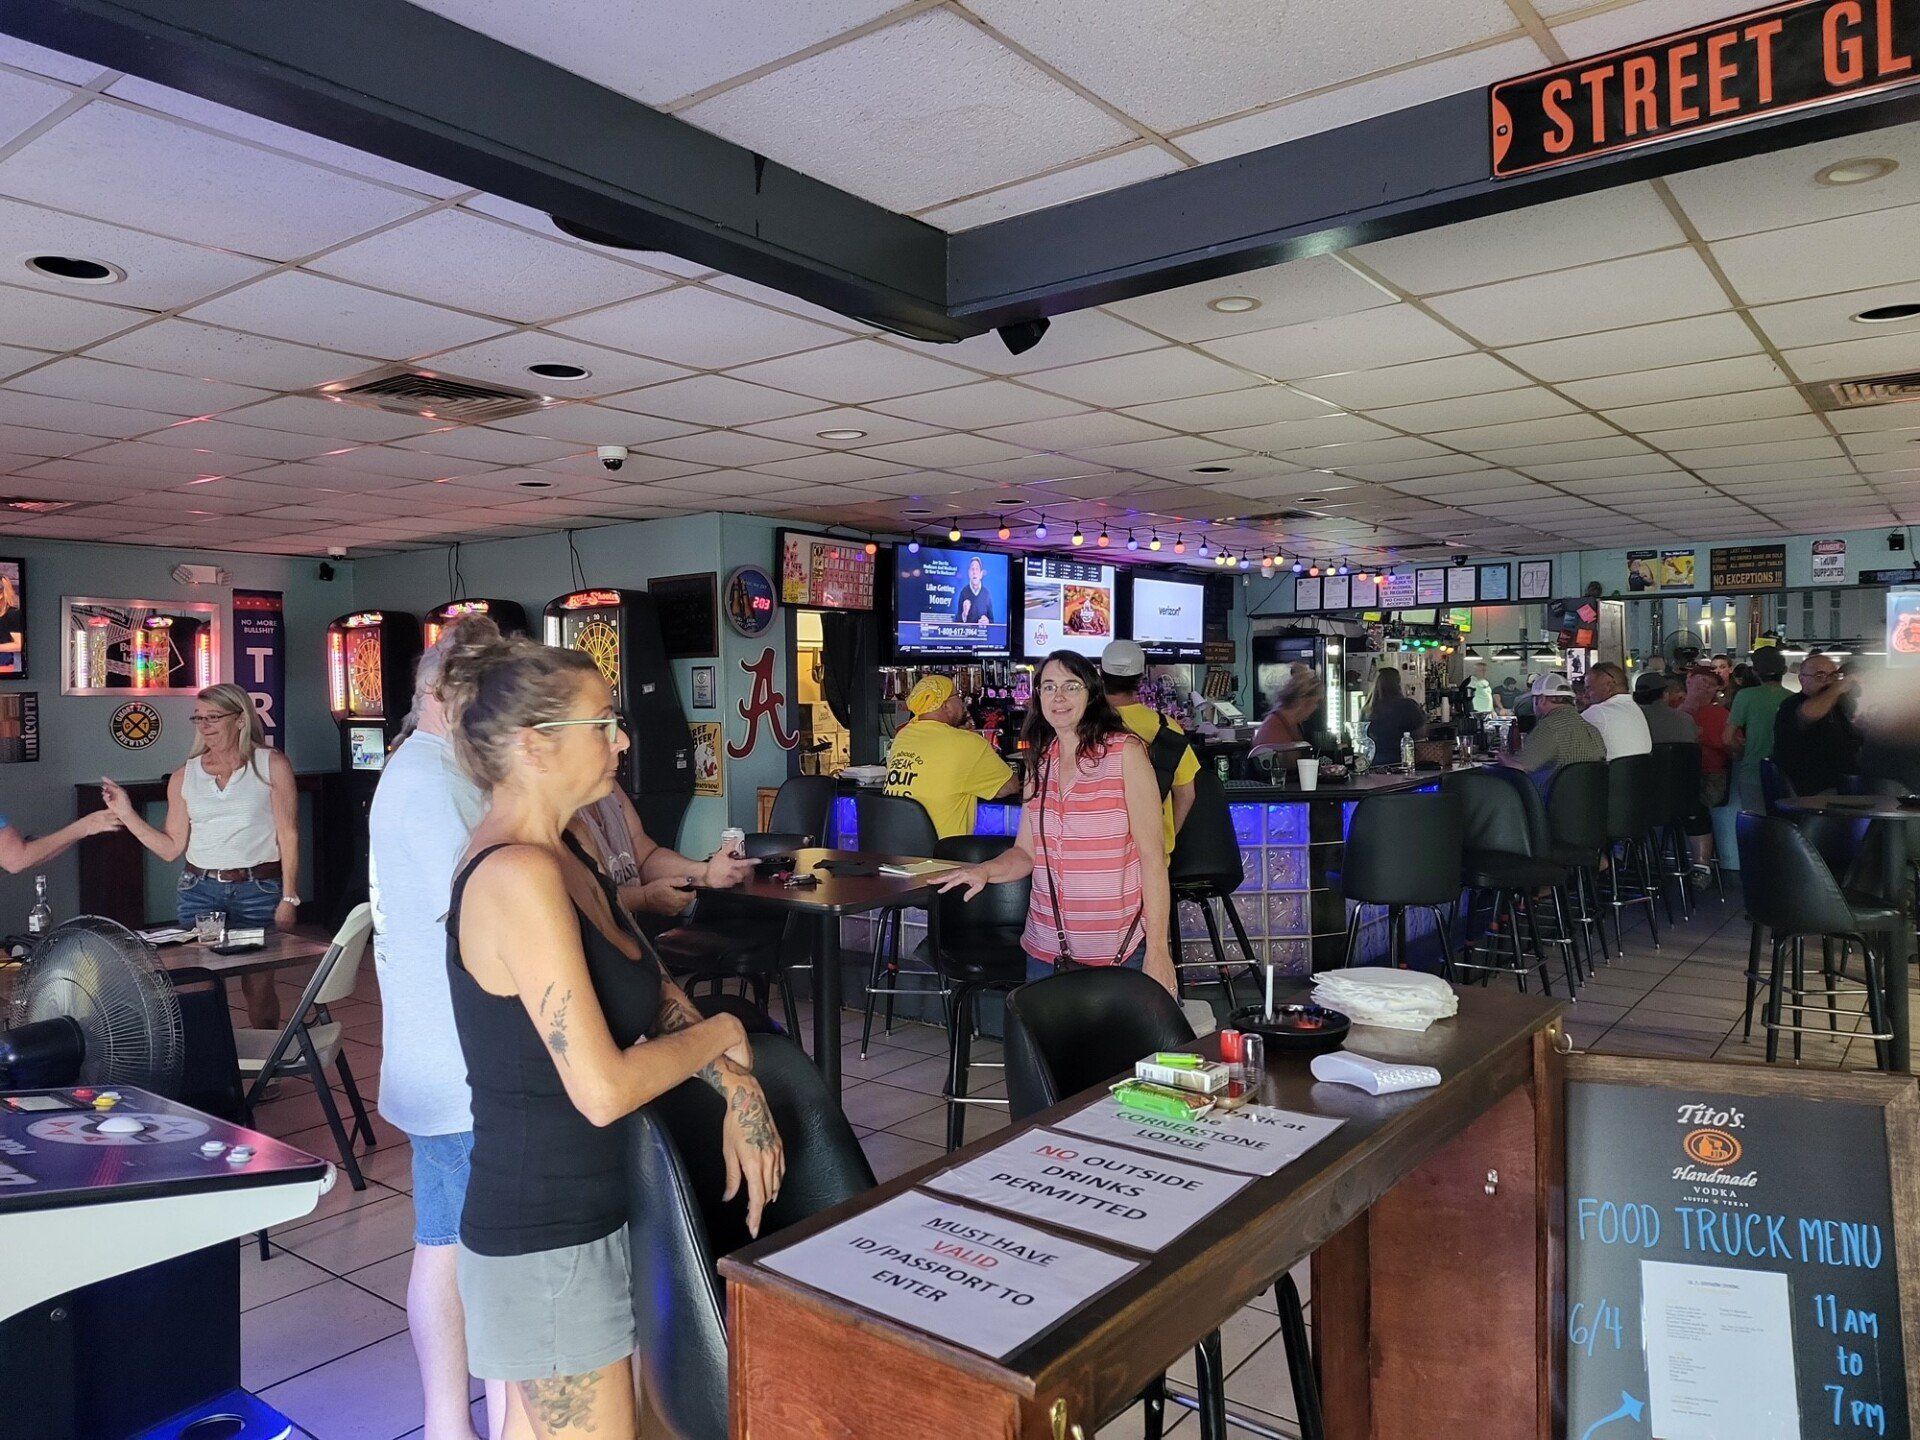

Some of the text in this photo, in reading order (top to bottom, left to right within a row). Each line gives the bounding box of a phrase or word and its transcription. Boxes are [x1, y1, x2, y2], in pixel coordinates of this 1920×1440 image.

[1542, 0, 1912, 153] STREET GL
[1820, 556, 1838, 566] TRUMP
[1713, 574, 1725, 586] NO
[1726, 571, 1774, 585] EXCEPTIONS
[1813, 567, 1844, 577] SUPPORTER
[926, 584, 955, 594] Like Getting
[929, 595, 952, 607] Money
[1158, 606, 1180, 616] verizon
[256, 619, 278, 627] MORE
[116, 704, 157, 721] GHOST TRAIN
[20, 698, 37, 760] unicorn
[116, 730, 150, 747] BREWING
[691, 723, 708, 738] REE
[896, 750, 924, 765] about to
[1195, 1114, 1222, 1127] he
[1282, 1120, 1310, 1132] at
[1115, 1111, 1271, 1151] CORNERSTONE
[1135, 1128, 1212, 1151] LODGE
[1035, 1145, 1204, 1191] NO OUTSIDE
[1672, 1164, 1758, 1187] Handmade
[1042, 1165, 1146, 1197] DRINKS
[989, 1173, 1148, 1220] PERMITTED
[1693, 1186, 1737, 1198] VODKA
[1723, 1200, 1749, 1208] TEXAS
[926, 1217, 1060, 1266] MUST HAVE
[1578, 1198, 1883, 1269] FOOD TRUCK MENU
[931, 1240, 1000, 1268] VALID
[848, 1236, 1035, 1306] ID/PASSPORT TO
[871, 1269, 948, 1302] ENTER
[1569, 1299, 1623, 1357] 6/4
[1838, 1345, 1864, 1376] to
